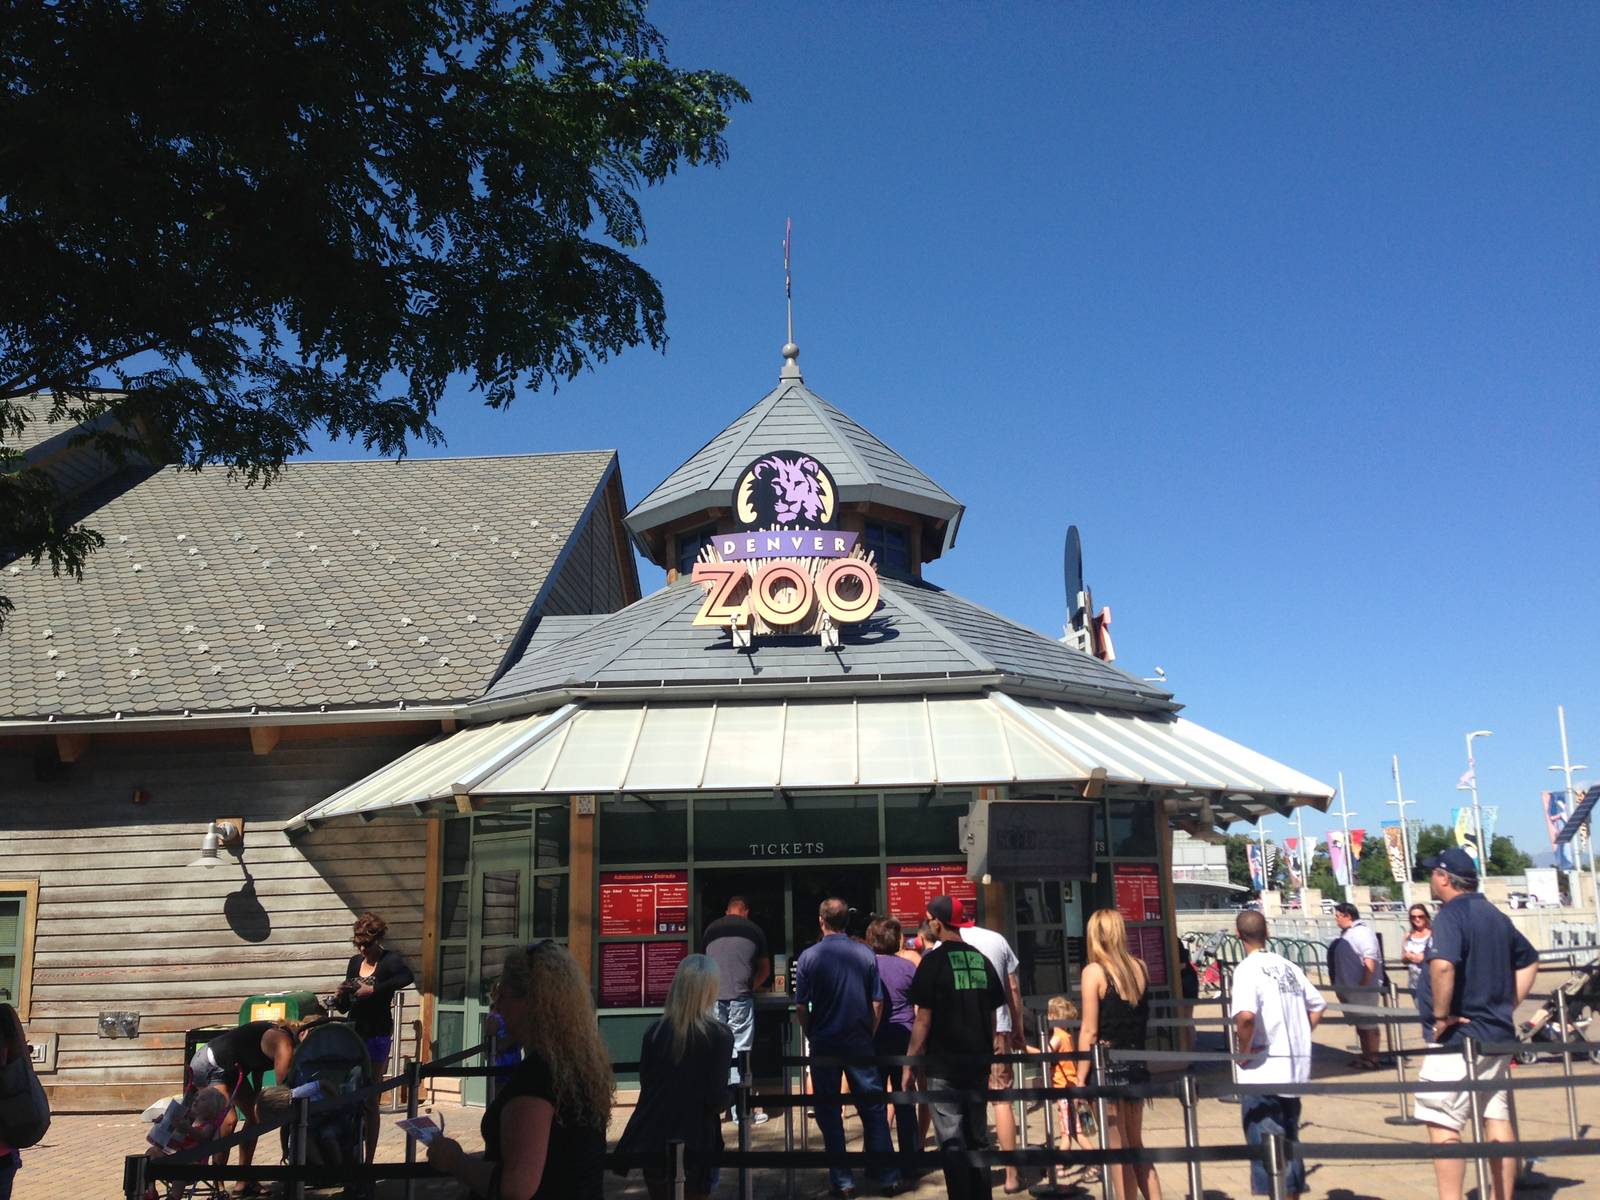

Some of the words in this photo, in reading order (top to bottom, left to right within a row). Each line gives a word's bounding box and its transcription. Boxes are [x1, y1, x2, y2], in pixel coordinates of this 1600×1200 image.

[723, 536, 846, 555] DENVER
[690, 557, 880, 626] ZOO
[749, 842, 824, 855] TICKETS
